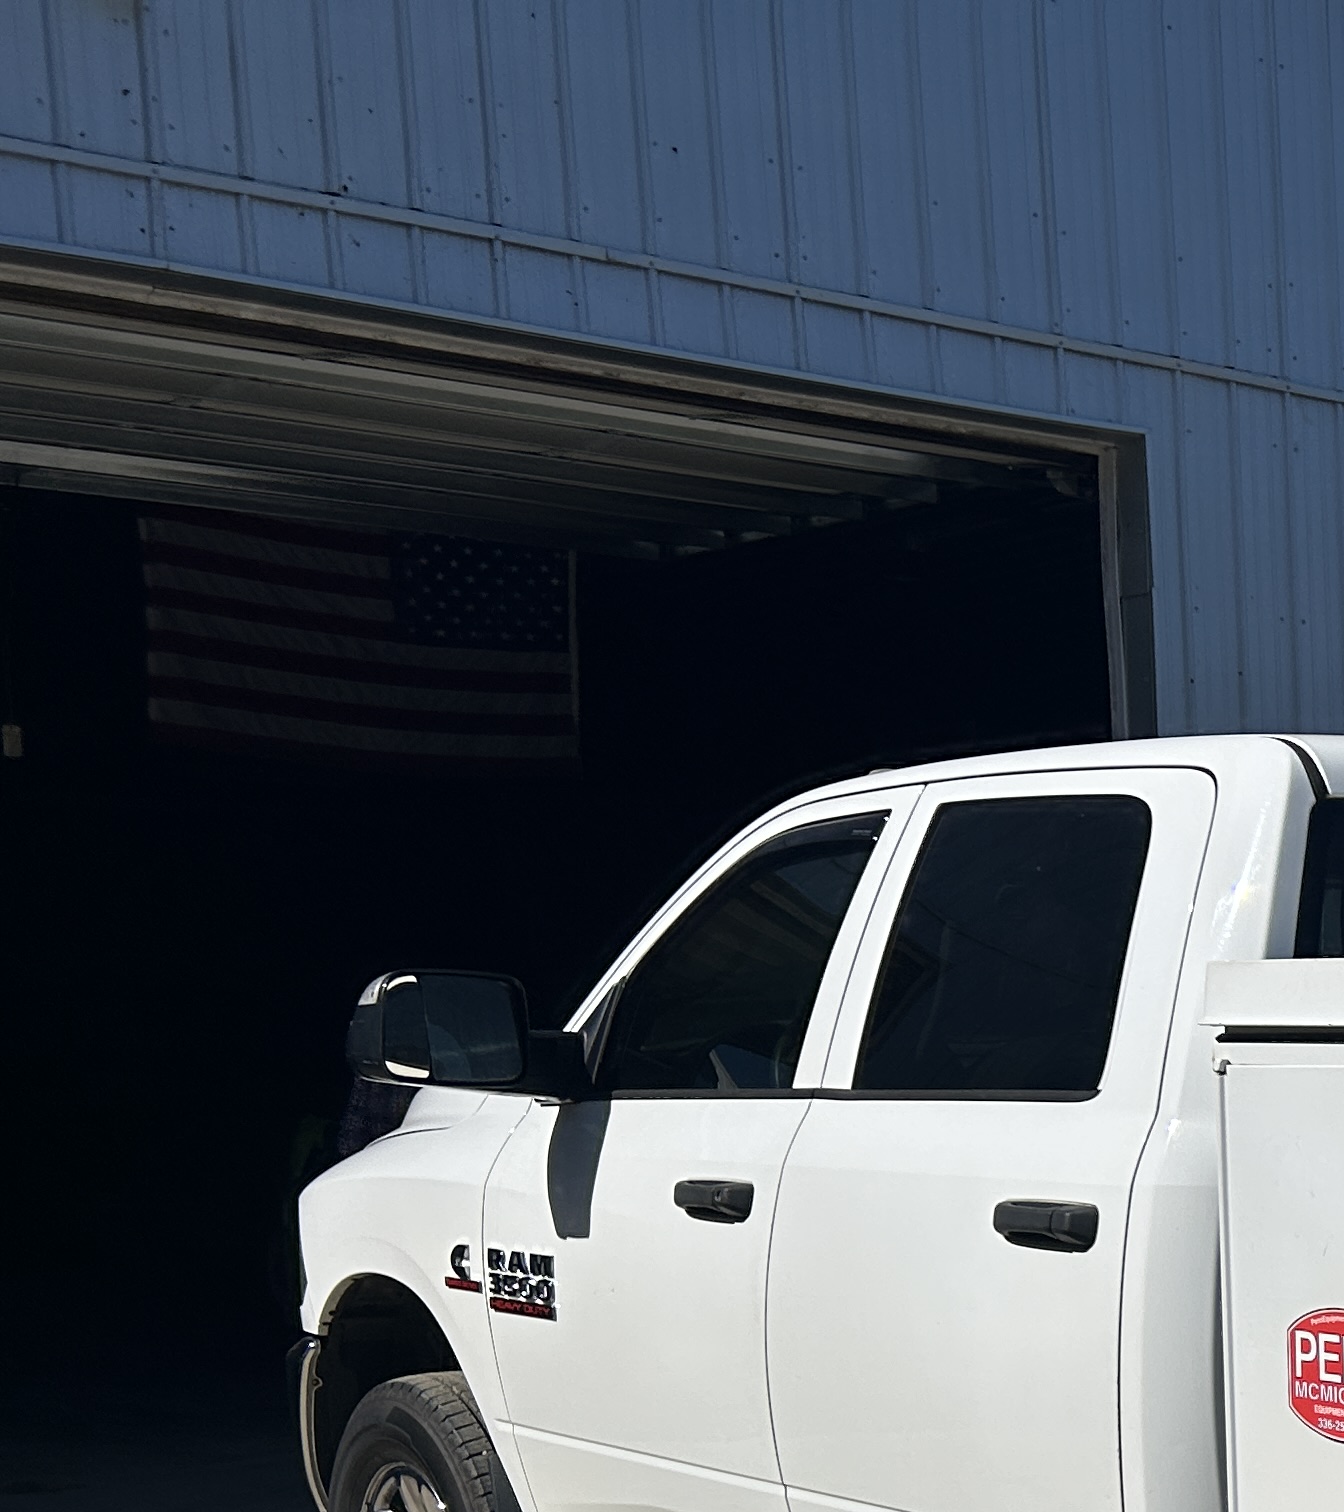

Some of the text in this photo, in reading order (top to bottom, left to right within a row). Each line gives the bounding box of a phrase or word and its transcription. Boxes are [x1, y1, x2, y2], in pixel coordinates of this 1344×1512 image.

[487, 1248, 555, 1279] RAM
[488, 1272, 556, 1306] 3500
[491, 1300, 551, 1316] HEAVY DUTY
